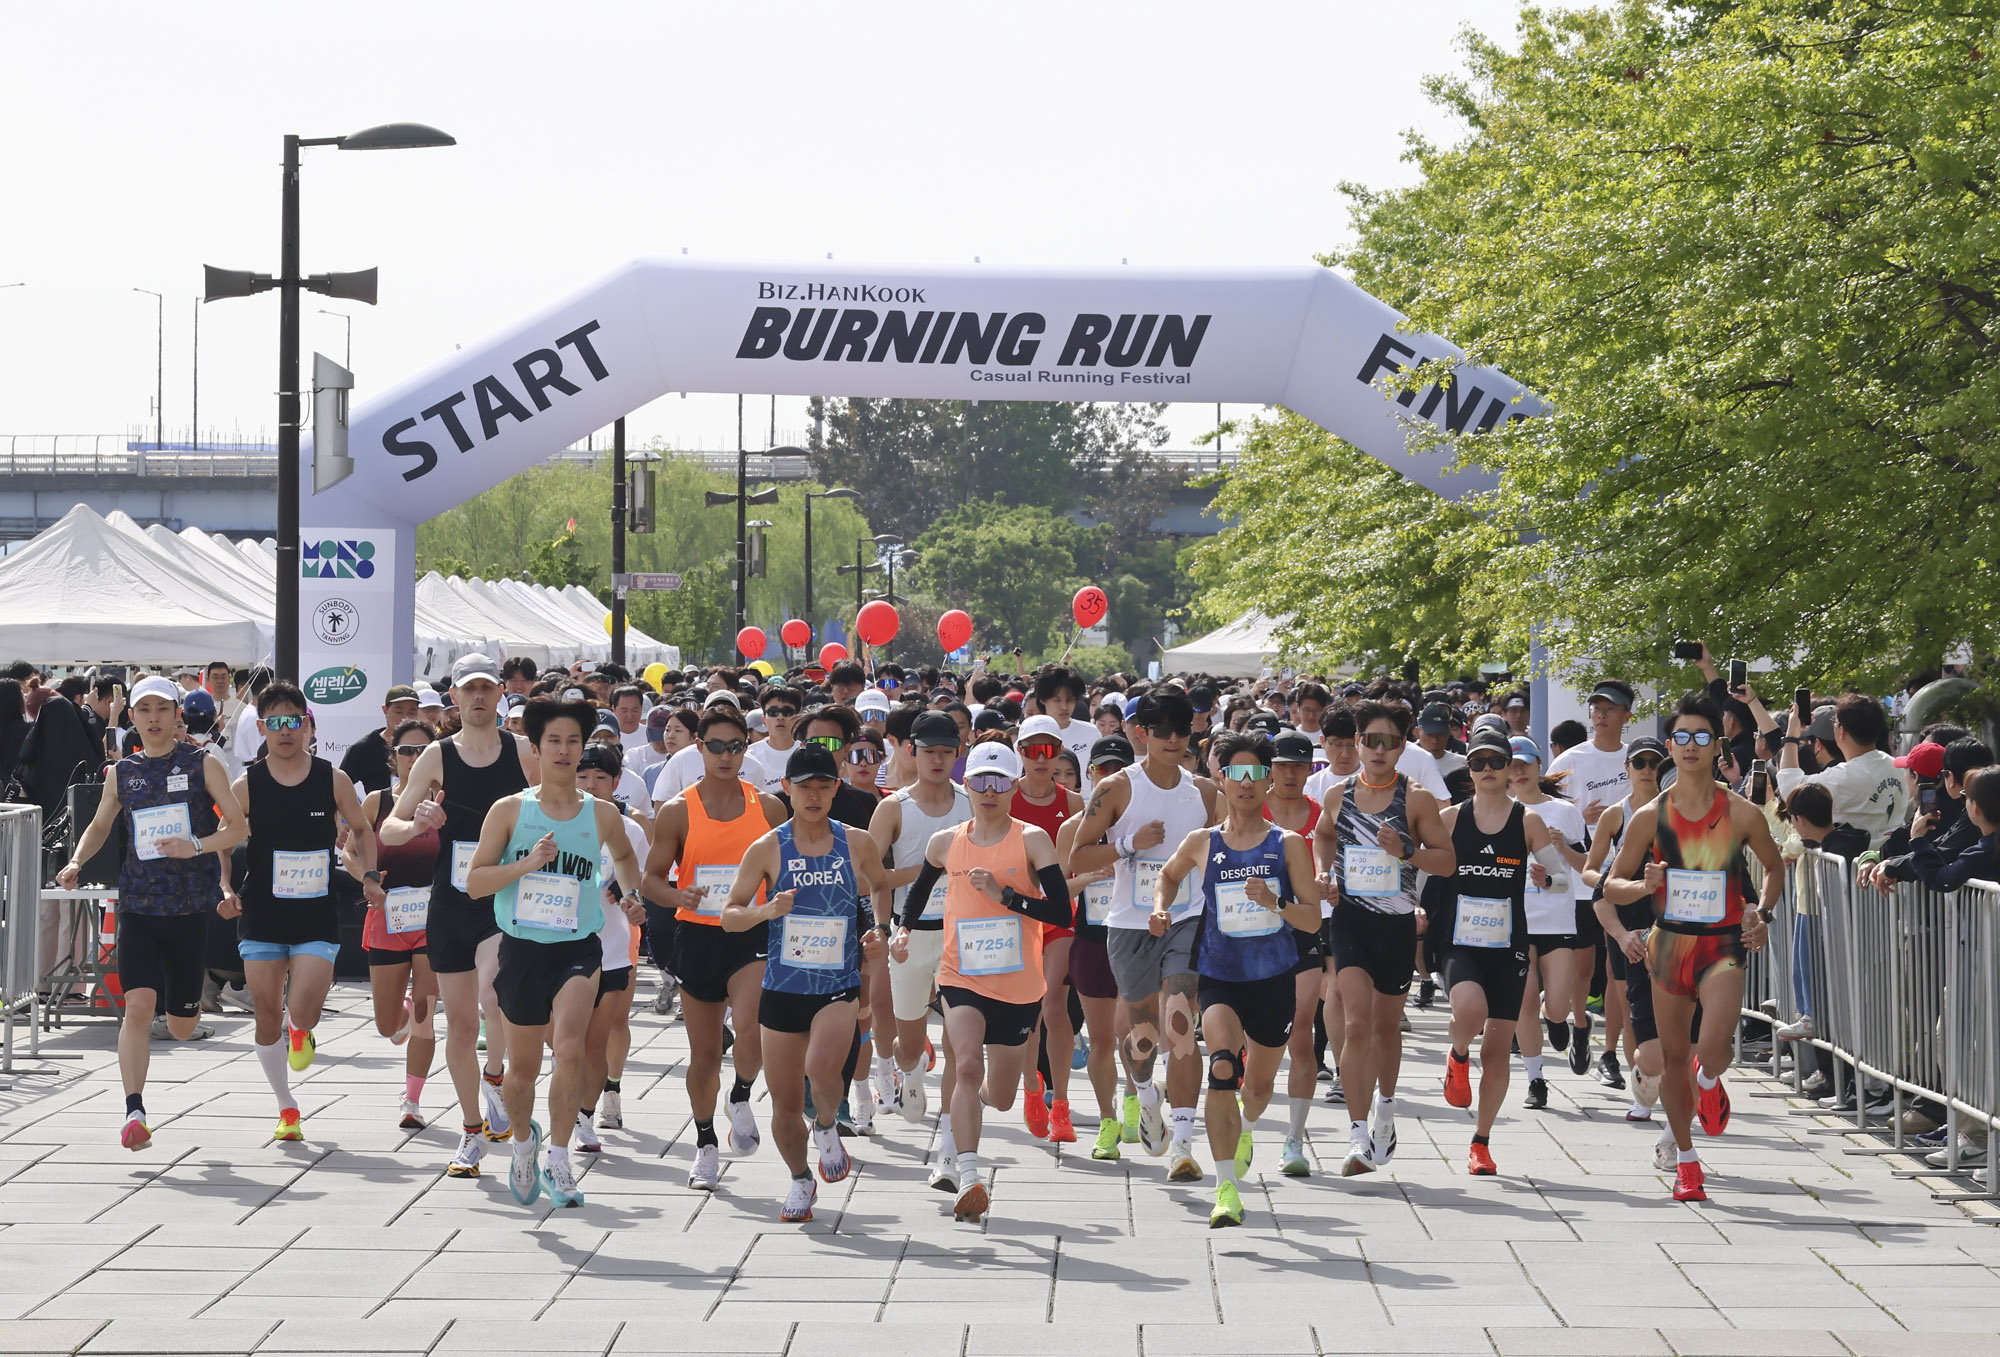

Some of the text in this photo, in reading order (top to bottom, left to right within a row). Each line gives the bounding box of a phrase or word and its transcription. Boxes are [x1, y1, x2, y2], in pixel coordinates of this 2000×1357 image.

[736, 307, 1213, 367] BURNING RUN
[970, 370, 1191, 386] Casual Running Festival
[1356, 333, 1531, 437] FINI
[382, 319, 609, 482] START
[303, 540, 375, 559] MONO
[302, 559, 375, 579] MANO
[318, 600, 354, 614] SUNBODY
[1080, 592, 1104, 615] 35
[321, 632, 350, 643] TANNING
[310, 674, 361, 699] 셀렉스
[1586, 777, 1618, 791] Burning
[140, 822, 183, 838] M 7408
[459, 861, 468, 869] M
[1359, 865, 1392, 876] 7364
[1458, 865, 1515, 878] SPOCARE
[290, 868, 323, 879] 7110
[792, 870, 844, 887] KOREA
[1220, 865, 1271, 880] DESCENTE
[1140, 878, 1149, 887] M
[523, 892, 573, 908] M 7395
[1673, 889, 1718, 900] M 7140
[391, 901, 429, 913] W 809
[1224, 905, 1233, 914] M
[556, 917, 573, 926] B-27
[1471, 915, 1505, 927] 8584
[790, 935, 838, 947] M 7269
[965, 937, 1014, 951] M 7254
